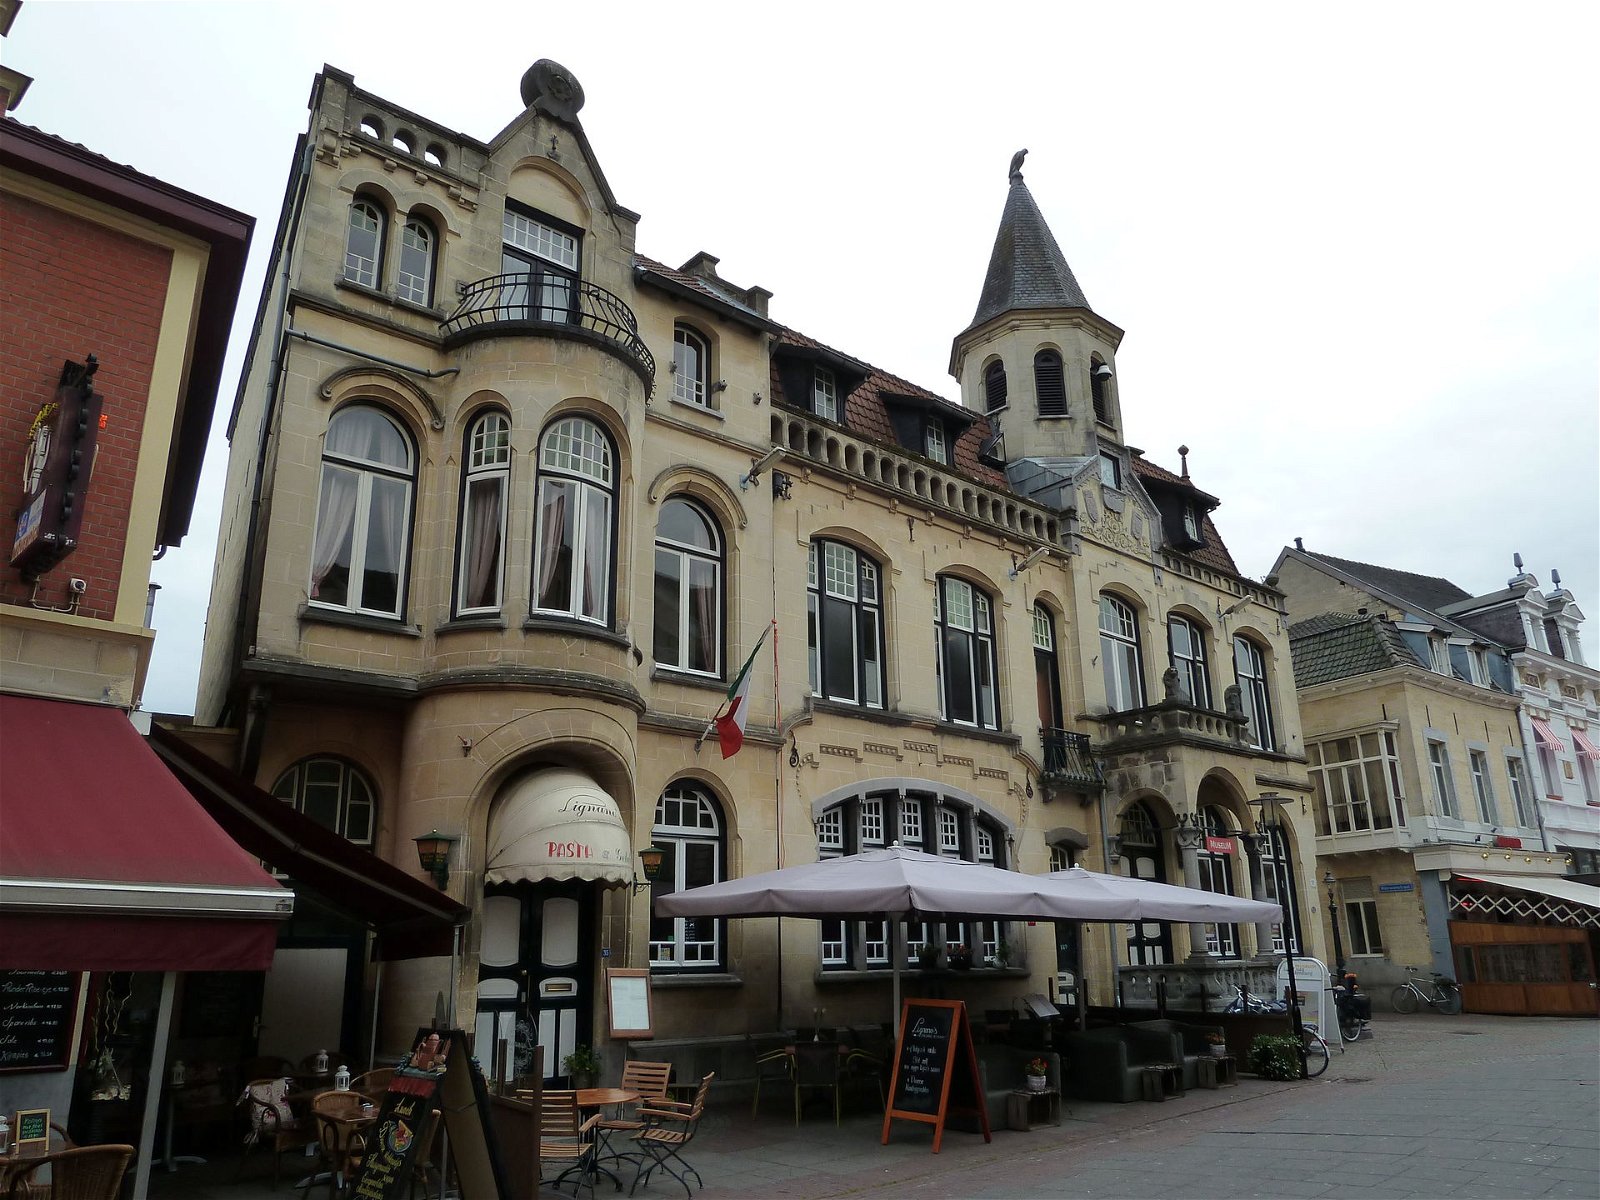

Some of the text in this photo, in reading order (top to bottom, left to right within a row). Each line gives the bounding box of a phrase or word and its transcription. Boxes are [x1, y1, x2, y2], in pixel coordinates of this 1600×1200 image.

[544, 840, 593, 858] PASTA
[1209, 839, 1232, 851] MUSEUM
[602, 949, 609, 957] 35
